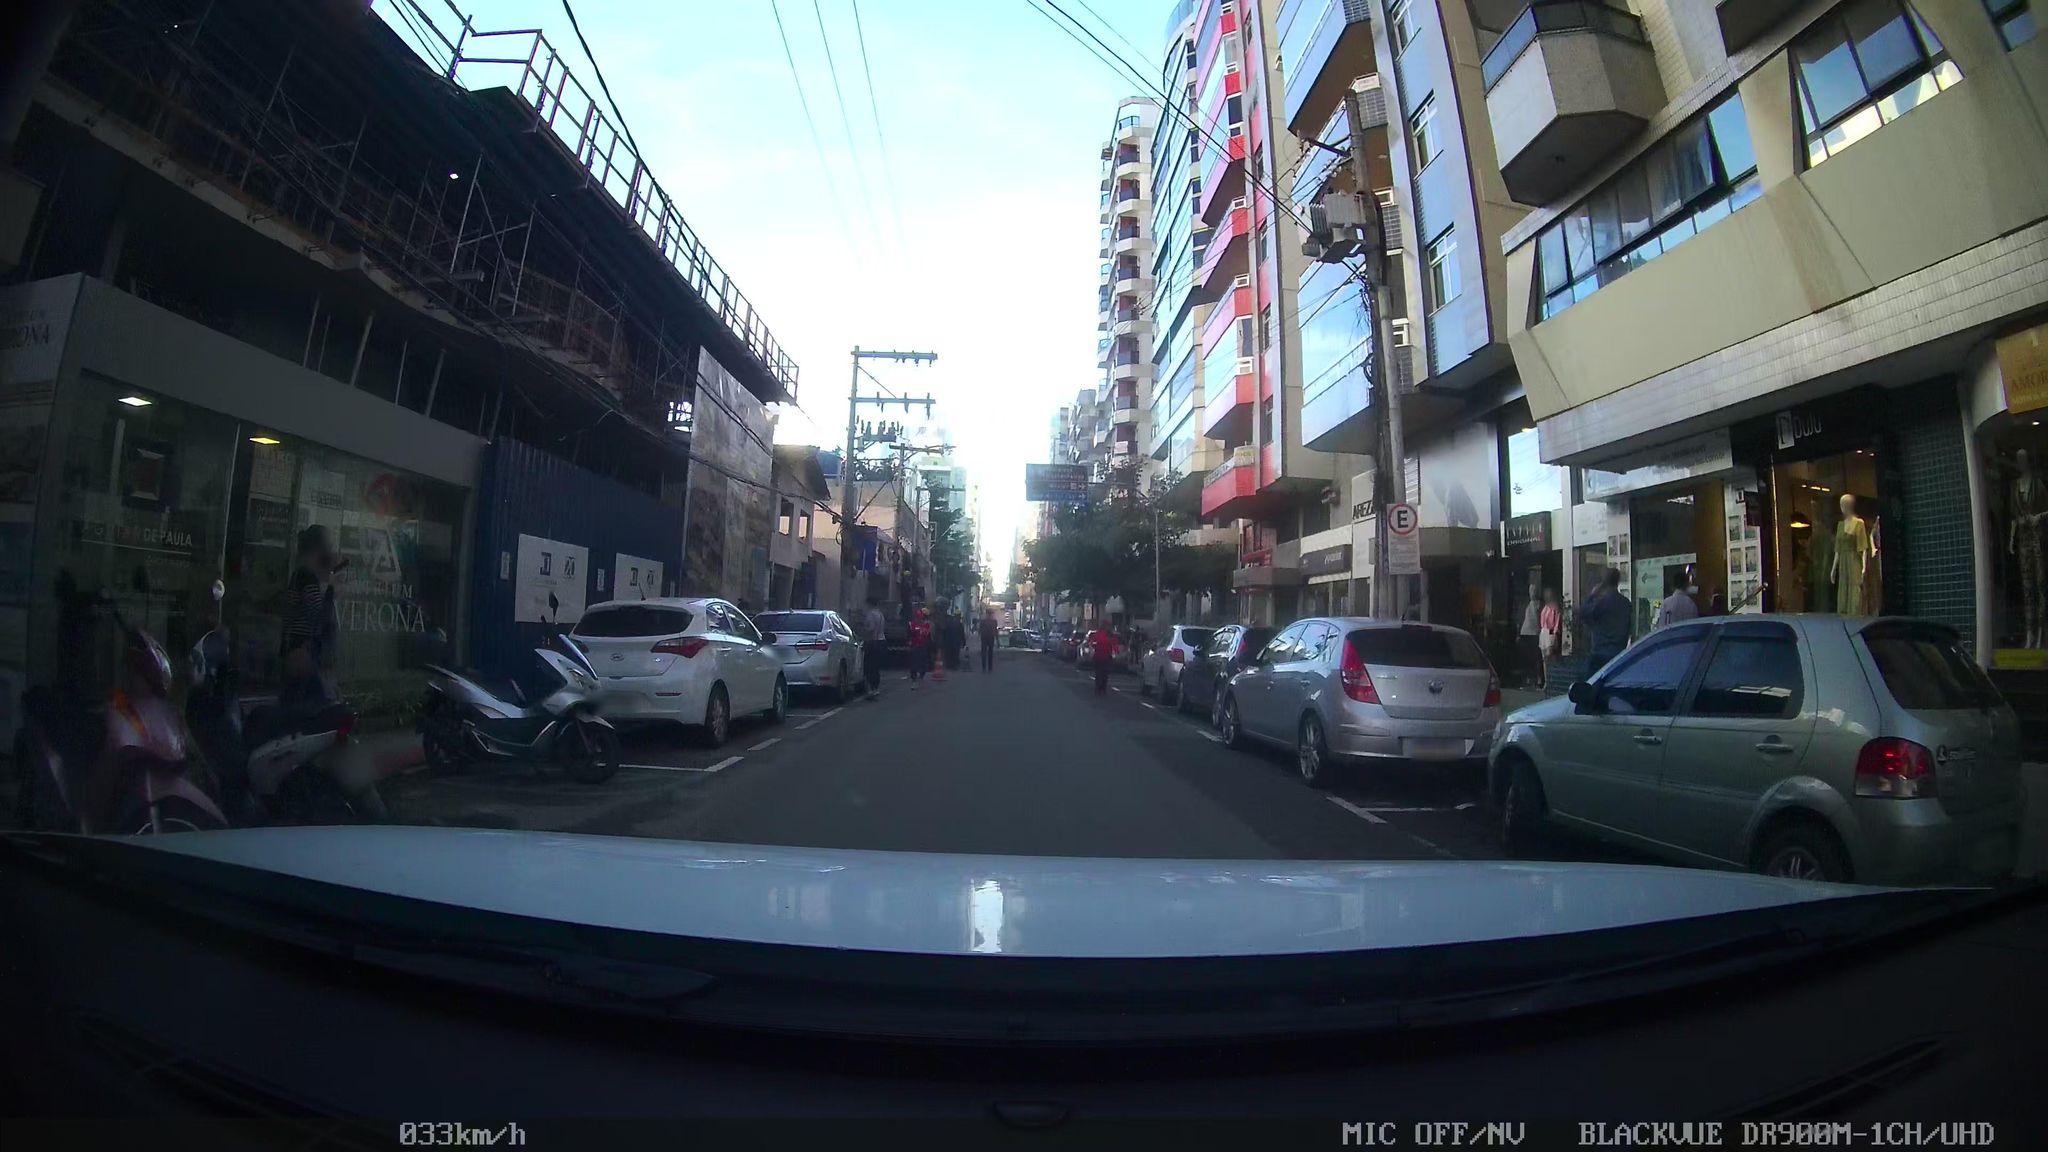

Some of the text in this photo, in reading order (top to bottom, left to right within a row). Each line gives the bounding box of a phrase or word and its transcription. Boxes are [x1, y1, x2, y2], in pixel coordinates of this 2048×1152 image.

[1397, 509, 1409, 529] E
[160, 529, 193, 546] PAULA
[334, 599, 426, 633] VERONA
